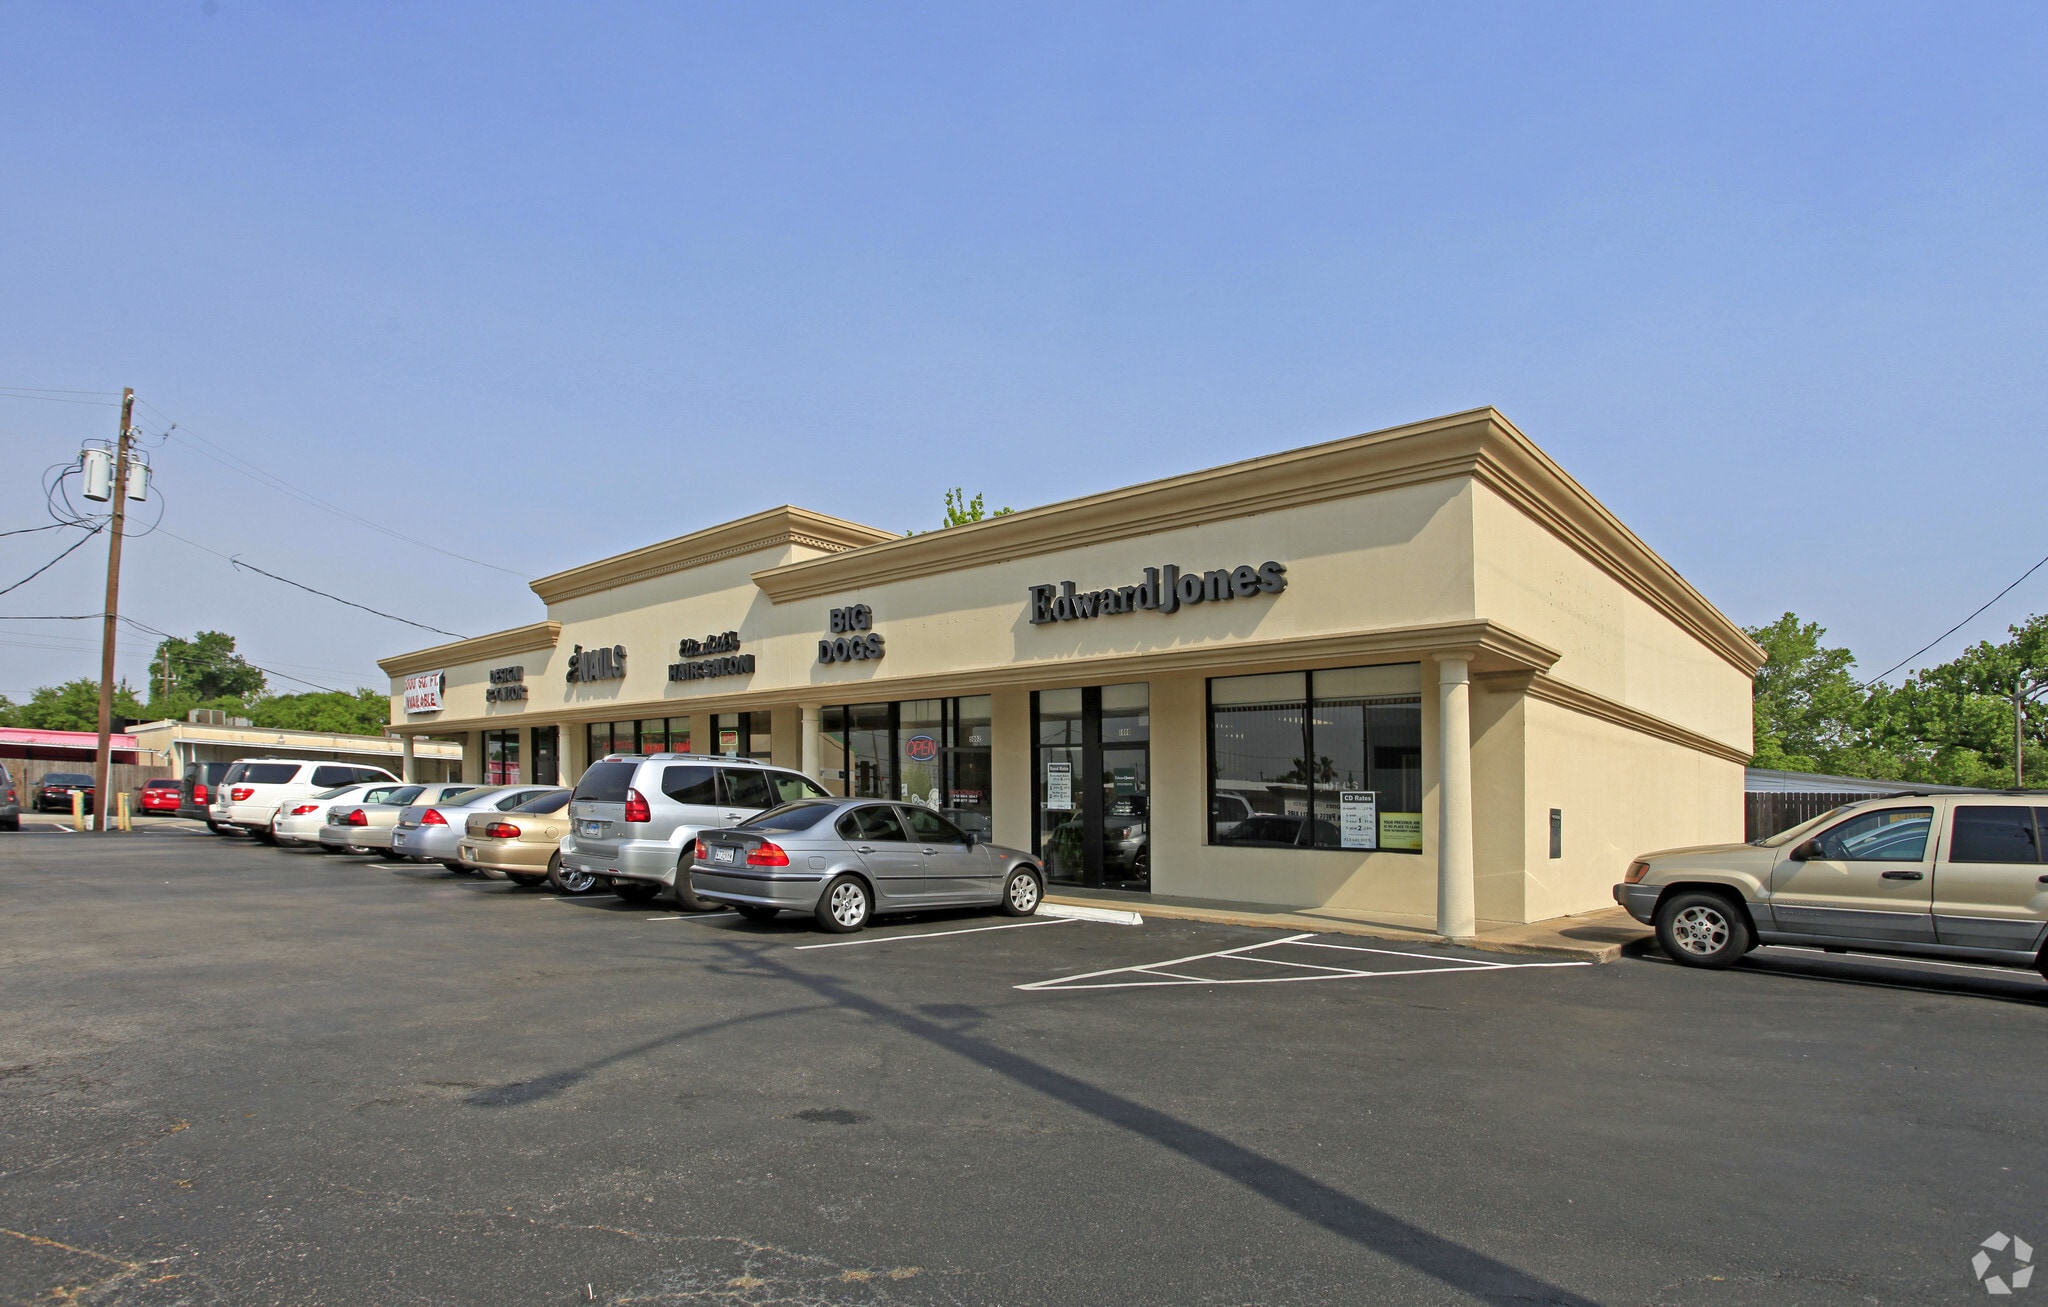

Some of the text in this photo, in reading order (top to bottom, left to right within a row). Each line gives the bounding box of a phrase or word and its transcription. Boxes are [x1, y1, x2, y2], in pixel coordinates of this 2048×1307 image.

[830, 604, 873, 633] BIG
[818, 633, 886, 664] DOGS
[489, 666, 524, 684] DESIGN
[668, 654, 755, 682] HAIR SALON
[905, 740, 937, 756] OPEN
